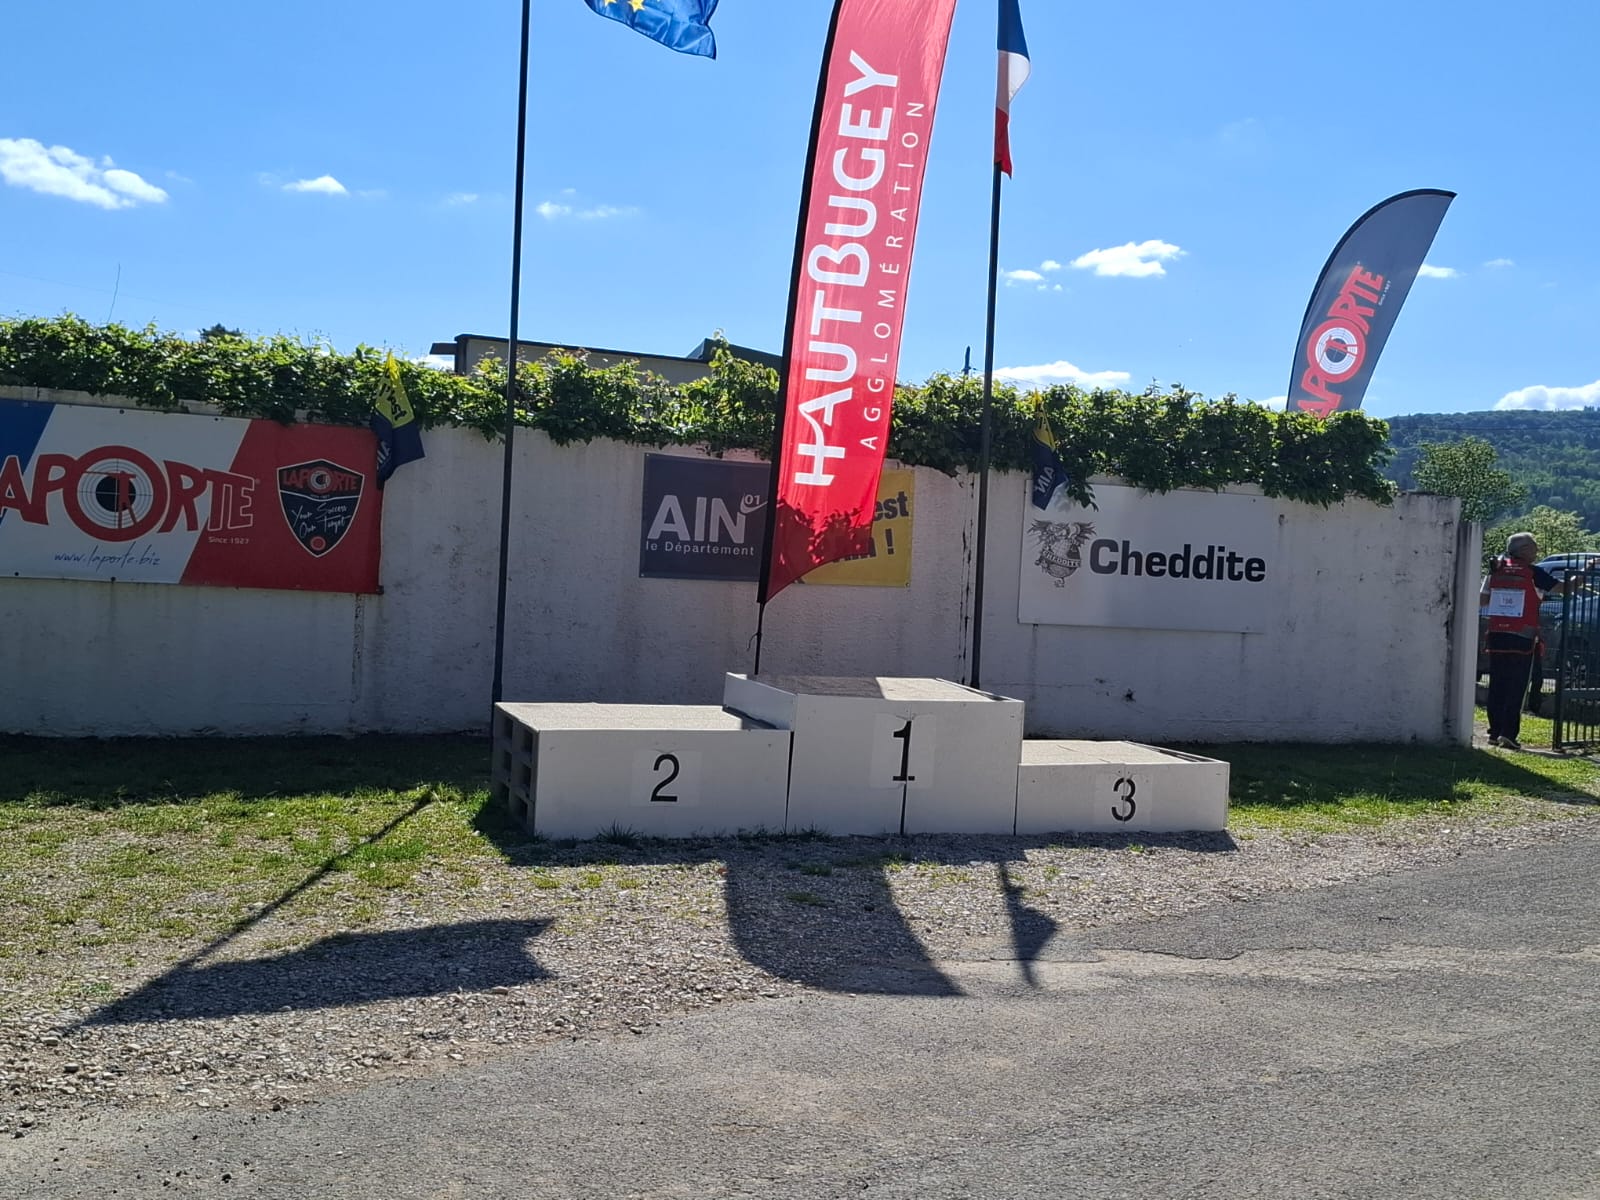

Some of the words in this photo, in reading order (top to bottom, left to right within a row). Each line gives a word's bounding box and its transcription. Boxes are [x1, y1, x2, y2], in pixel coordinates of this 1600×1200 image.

[859, 101, 924, 450] AGGLOMÉRATION
[1297, 264, 1384, 420] APORTE
[0, 445, 256, 542] APORTE
[875, 491, 909, 521] est
[647, 494, 746, 544] AIN
[54, 541, 161, 572] www.laporte.biz
[645, 541, 658, 551] le
[664, 541, 755, 556] Département
[1089, 538, 1266, 582] Cheddite
[892, 720, 916, 782] 1
[651, 754, 680, 802] 2
[1111, 777, 1136, 822] 3
